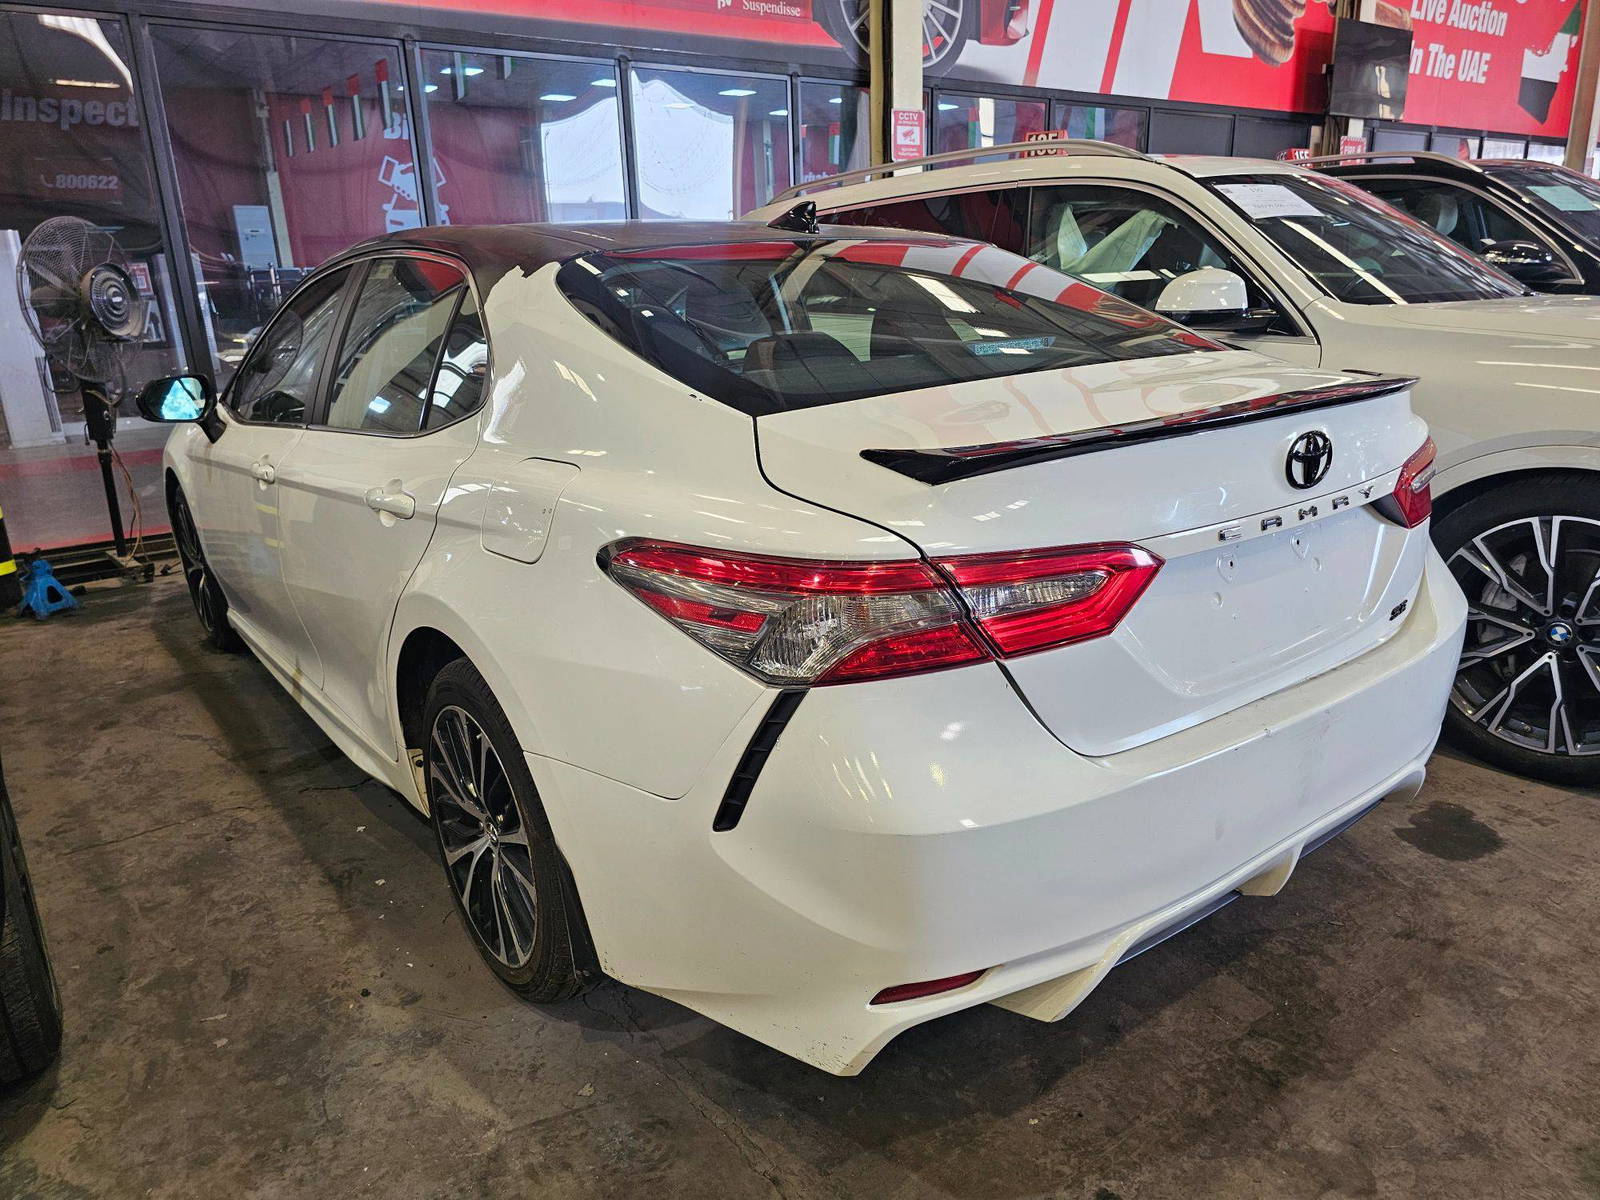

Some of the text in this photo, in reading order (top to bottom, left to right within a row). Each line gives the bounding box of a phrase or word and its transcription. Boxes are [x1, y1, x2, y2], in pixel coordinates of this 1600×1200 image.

[742, 0, 801, 17] Suspendisse
[1410, 0, 1508, 37] Live Auction
[1426, 43, 1456, 80] The
[1457, 49, 1492, 84] UAE
[898, 112, 918, 121] CCTV
[1218, 485, 1375, 542] CAMRY
